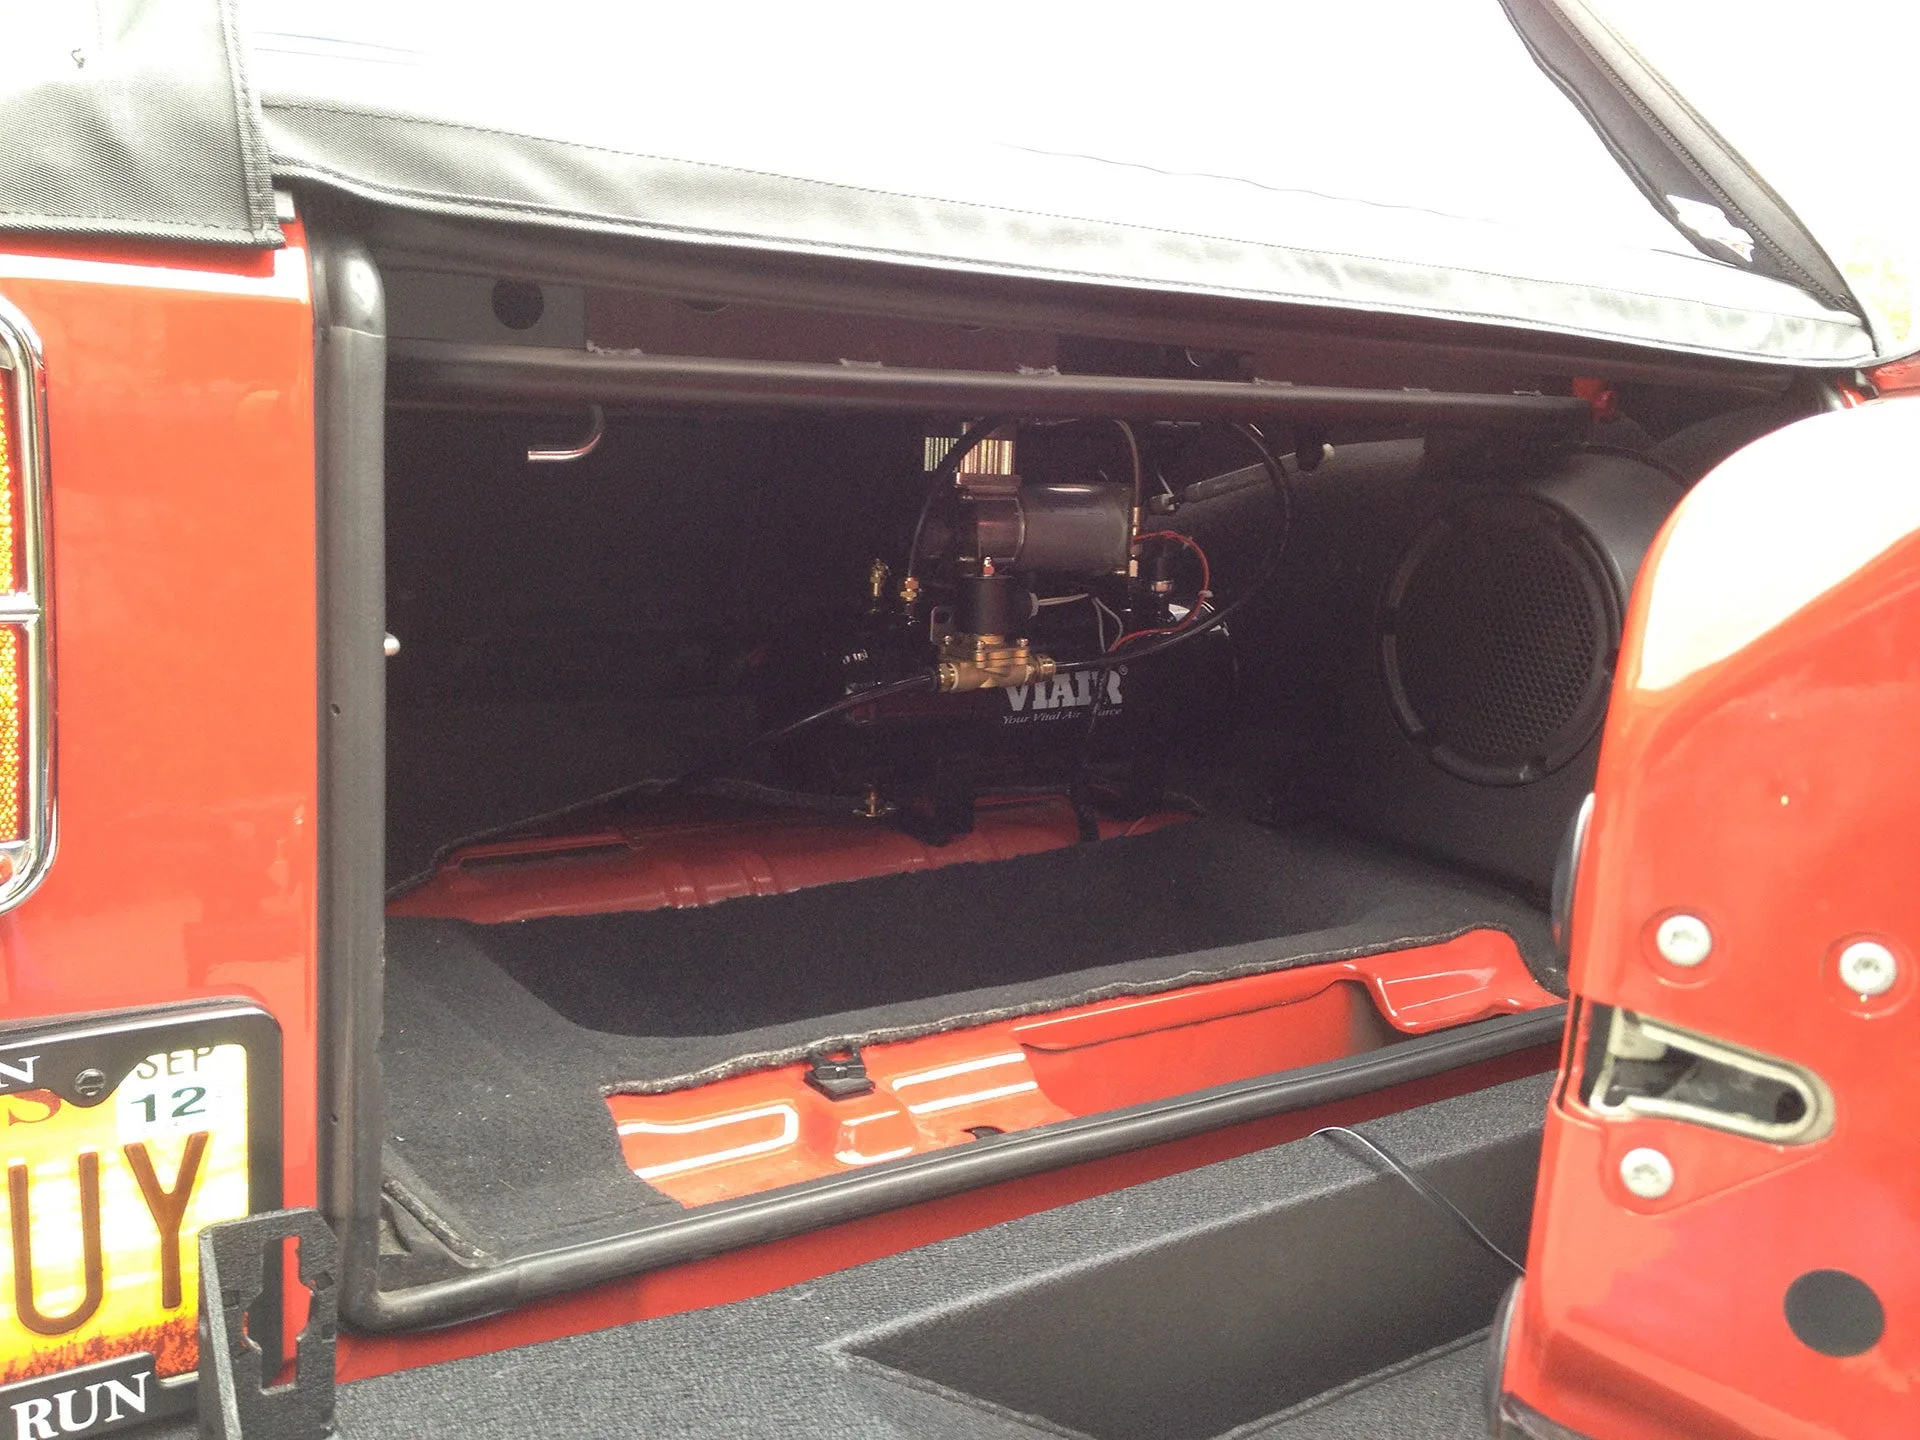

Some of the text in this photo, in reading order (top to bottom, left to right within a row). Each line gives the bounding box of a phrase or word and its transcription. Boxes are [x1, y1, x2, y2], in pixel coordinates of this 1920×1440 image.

[1005, 669, 1123, 712] VIAIR
[1002, 715, 1029, 725] Your
[1033, 711, 1061, 722] Vital
[1062, 711, 1082, 720] Air
[136, 1046, 214, 1080] SEP
[130, 1086, 207, 1123] 12
[7, 1130, 210, 1338] UY
[9, 1370, 151, 1440] RUN
